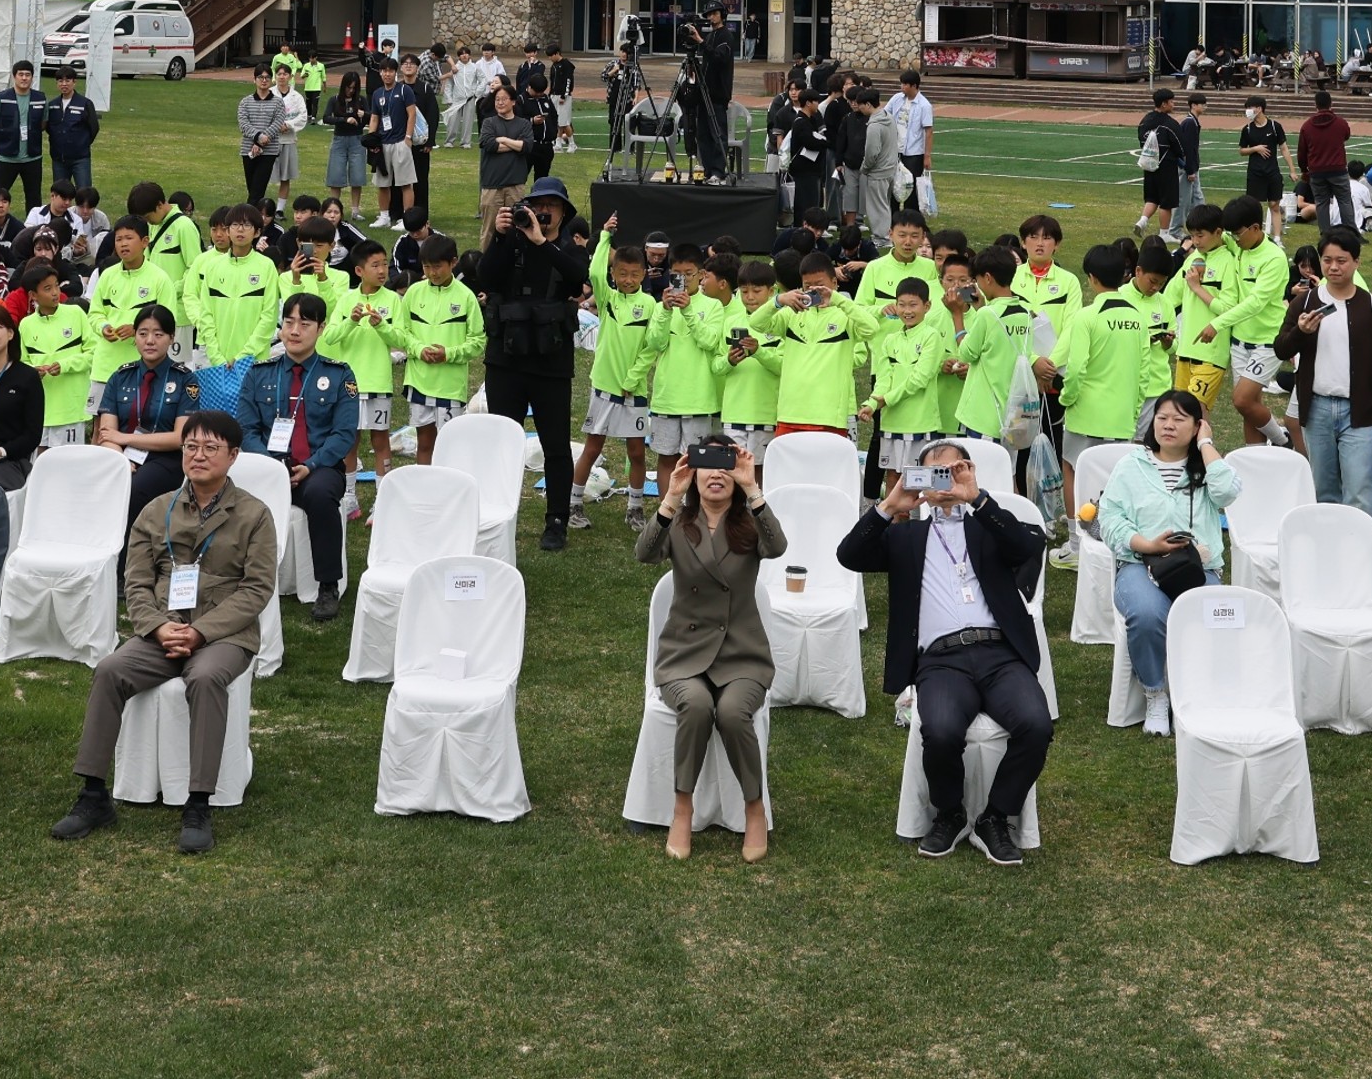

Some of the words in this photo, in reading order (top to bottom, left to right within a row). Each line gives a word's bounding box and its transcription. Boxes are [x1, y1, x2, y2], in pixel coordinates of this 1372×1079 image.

[172, 342, 181, 356] 9
[1245, 358, 1265, 376] 26
[1192, 378, 1209, 397] 31
[374, 410, 388, 425] 21
[635, 416, 645, 431] 6
[66, 428, 76, 442] 11
